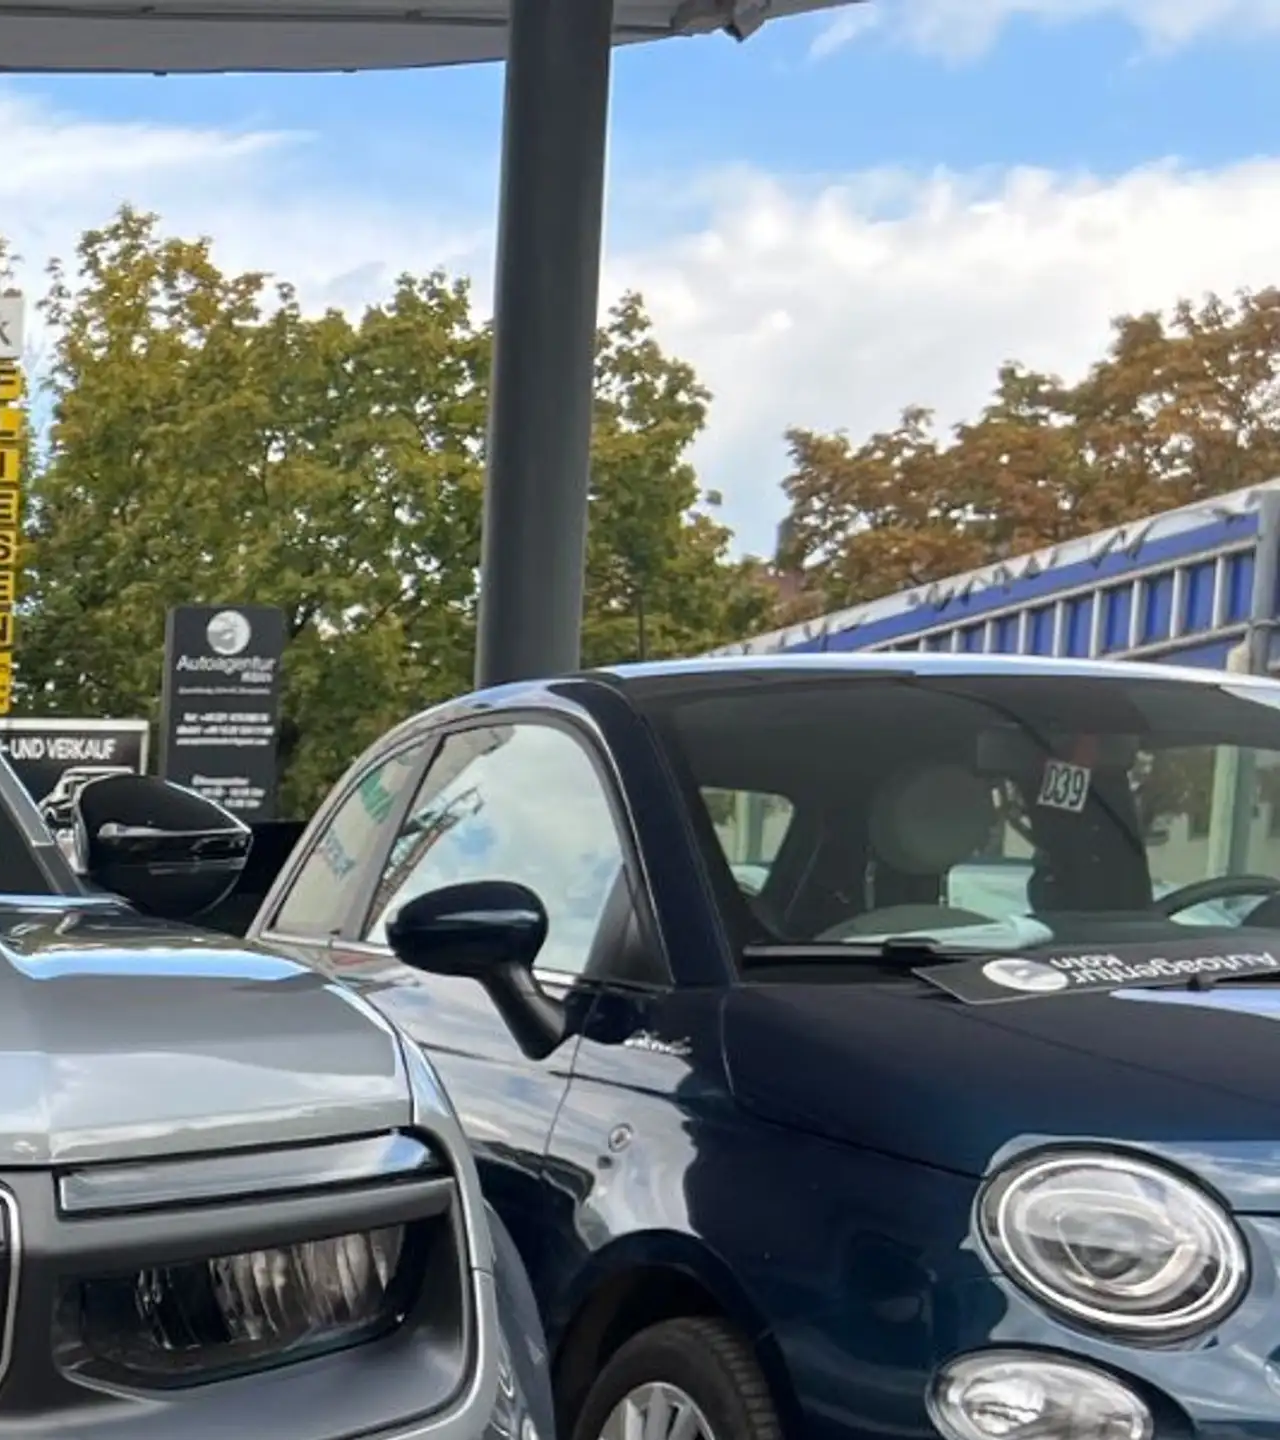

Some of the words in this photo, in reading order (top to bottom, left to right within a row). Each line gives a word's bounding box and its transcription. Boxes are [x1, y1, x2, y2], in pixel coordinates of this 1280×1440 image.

[10, 738, 45, 760] UND
[46, 737, 117, 760] VERKAUF
[1070, 951, 1279, 985] Autoagentur
